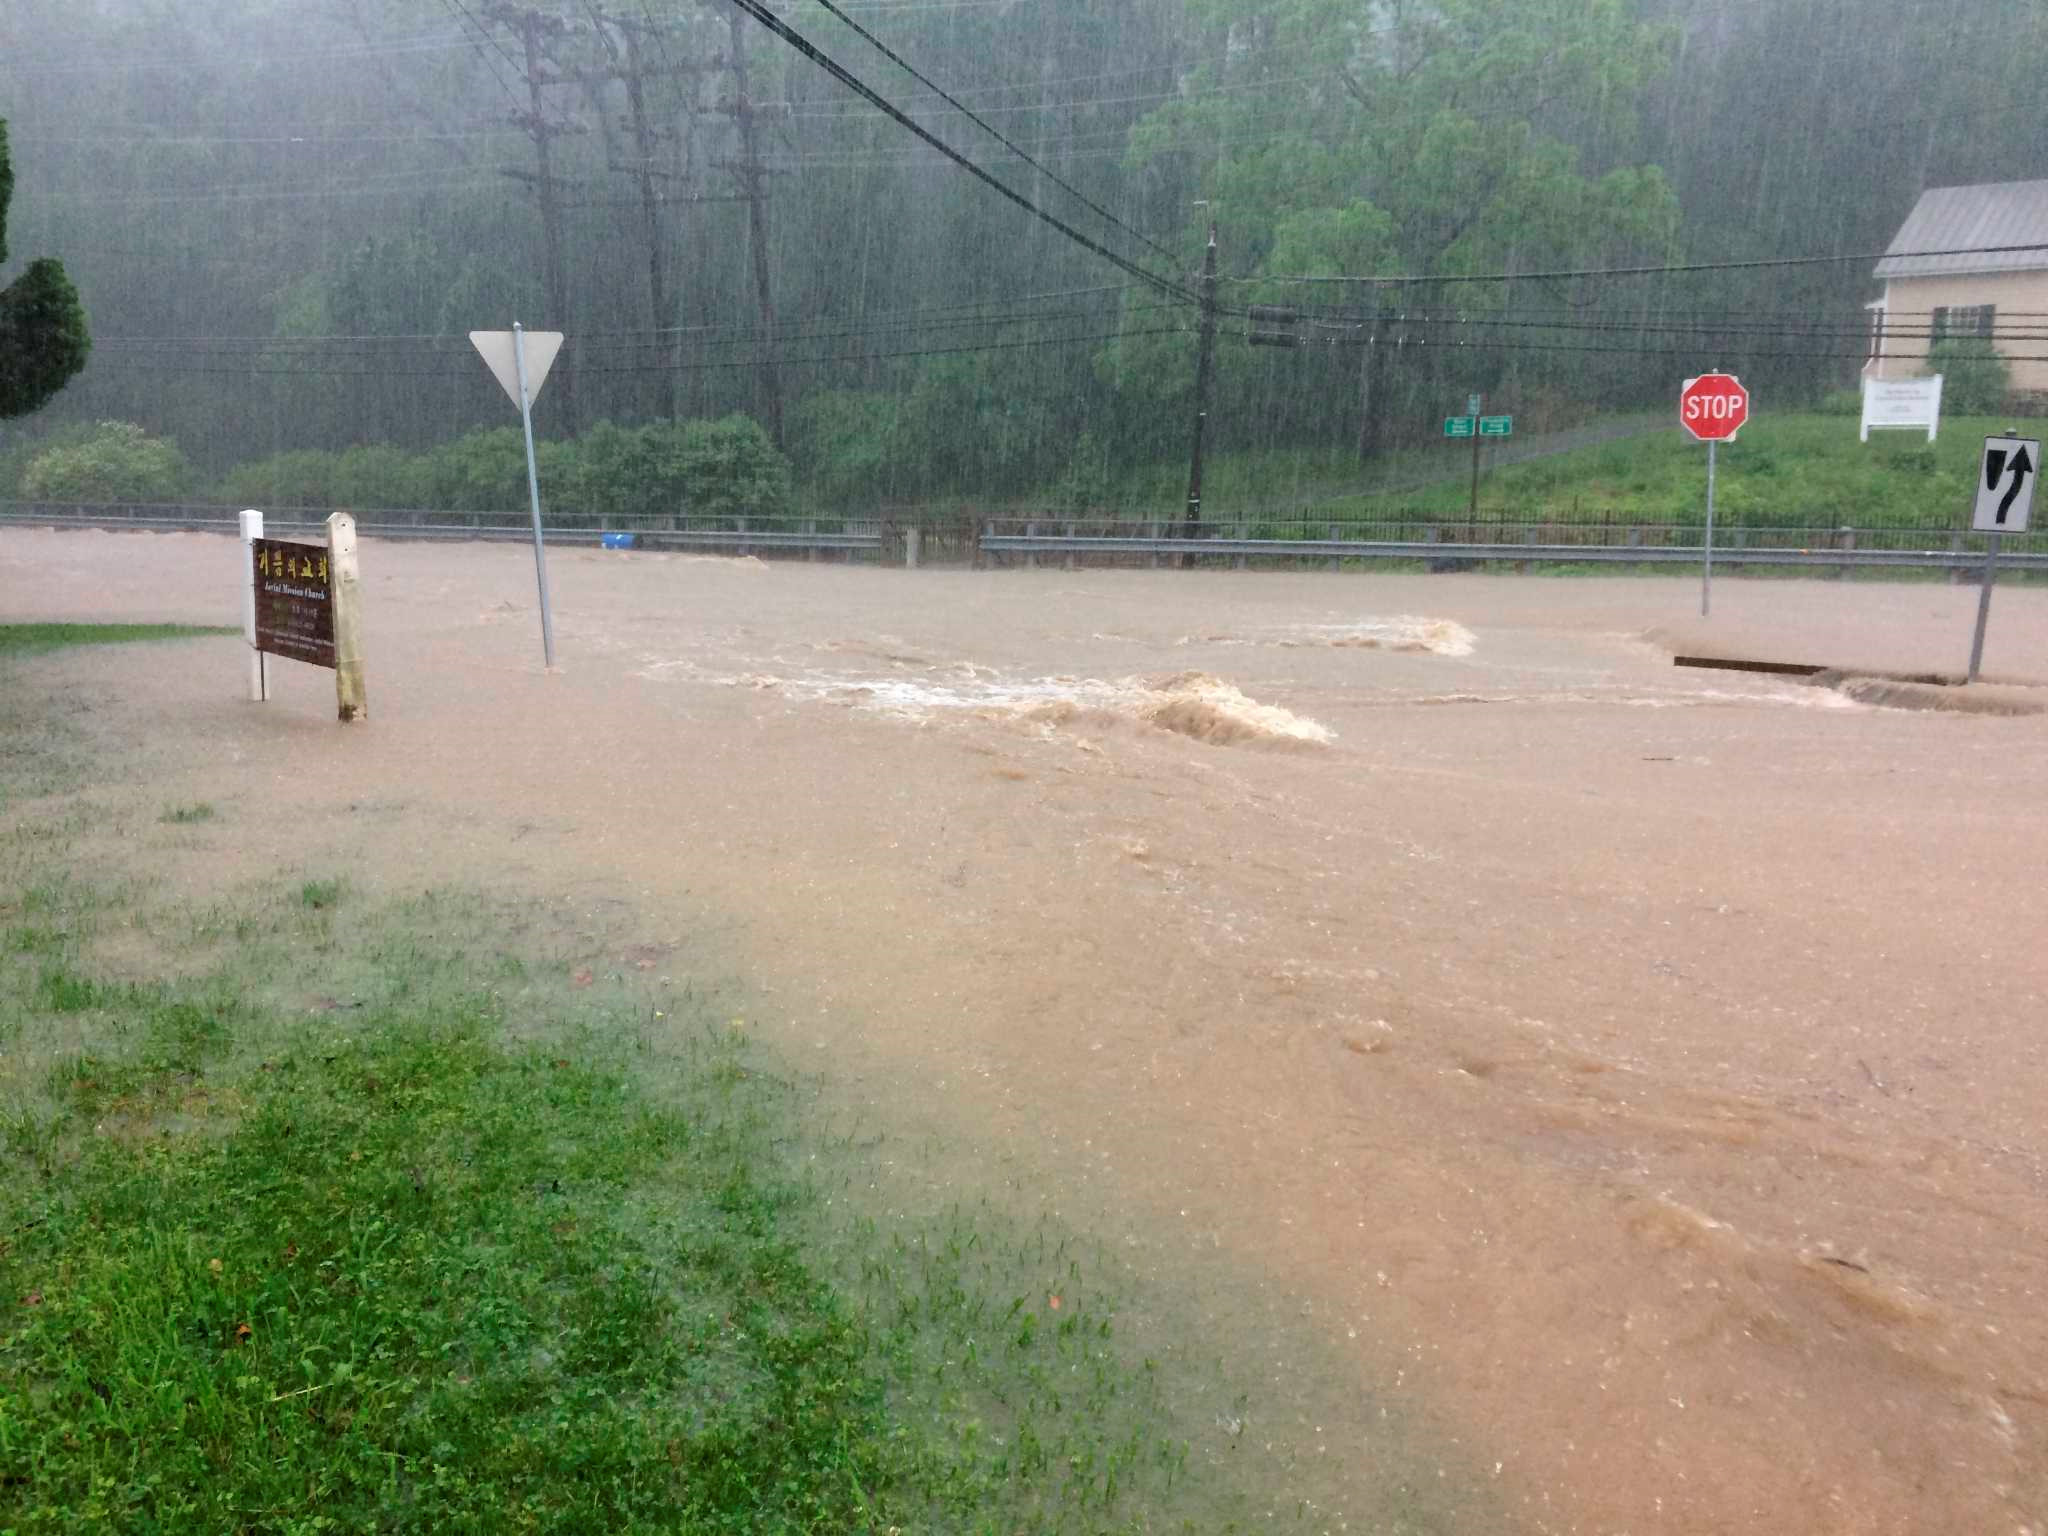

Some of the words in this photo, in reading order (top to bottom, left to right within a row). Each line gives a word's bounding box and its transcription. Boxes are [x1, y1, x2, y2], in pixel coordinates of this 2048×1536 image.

[1686, 395, 1743, 419] STOP
[282, 583, 303, 596] Mission
[304, 587, 325, 599] Church
